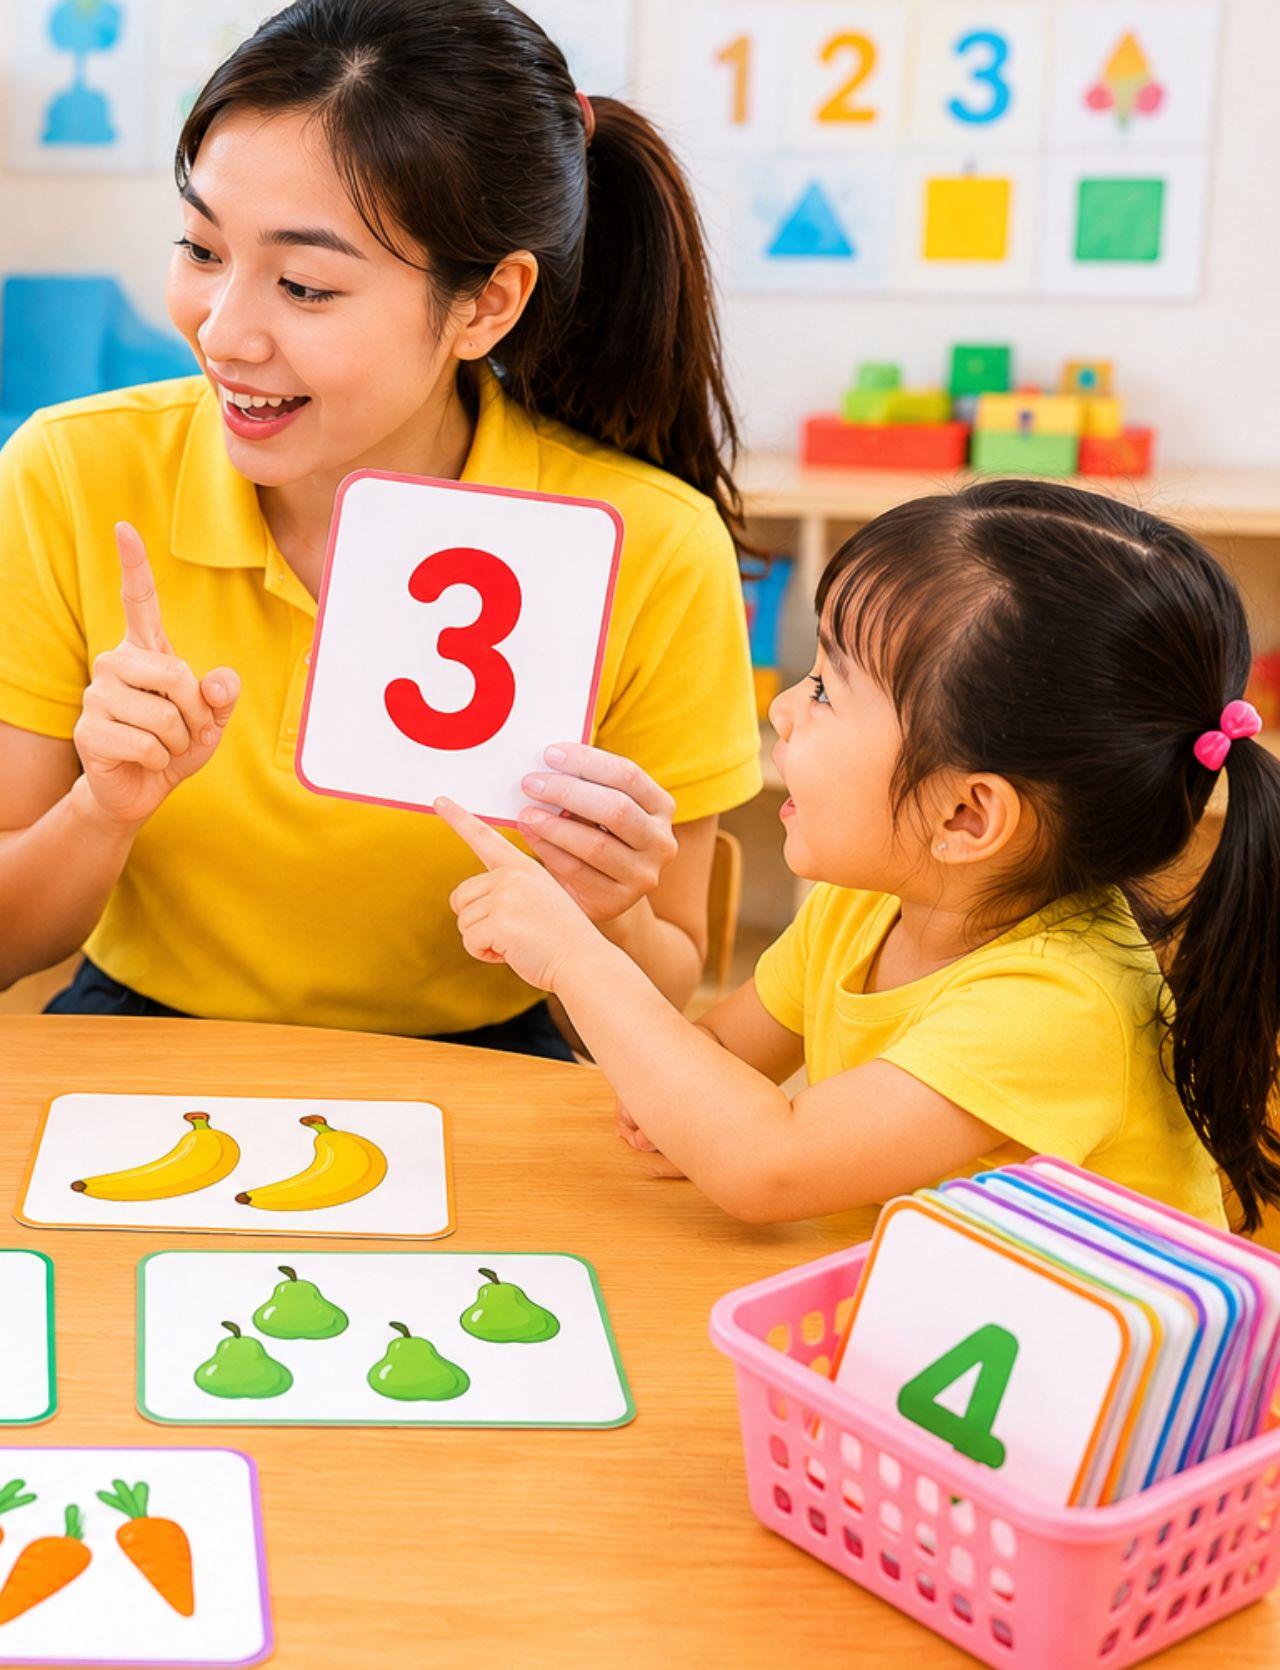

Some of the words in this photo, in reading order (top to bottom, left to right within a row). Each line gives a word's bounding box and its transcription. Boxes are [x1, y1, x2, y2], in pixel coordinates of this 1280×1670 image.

[716, 34, 751, 125] 1
[816, 29, 879, 125] 2
[947, 30, 1012, 126] 3
[384, 547, 522, 751] 3
[897, 1323, 1019, 1469] 4
